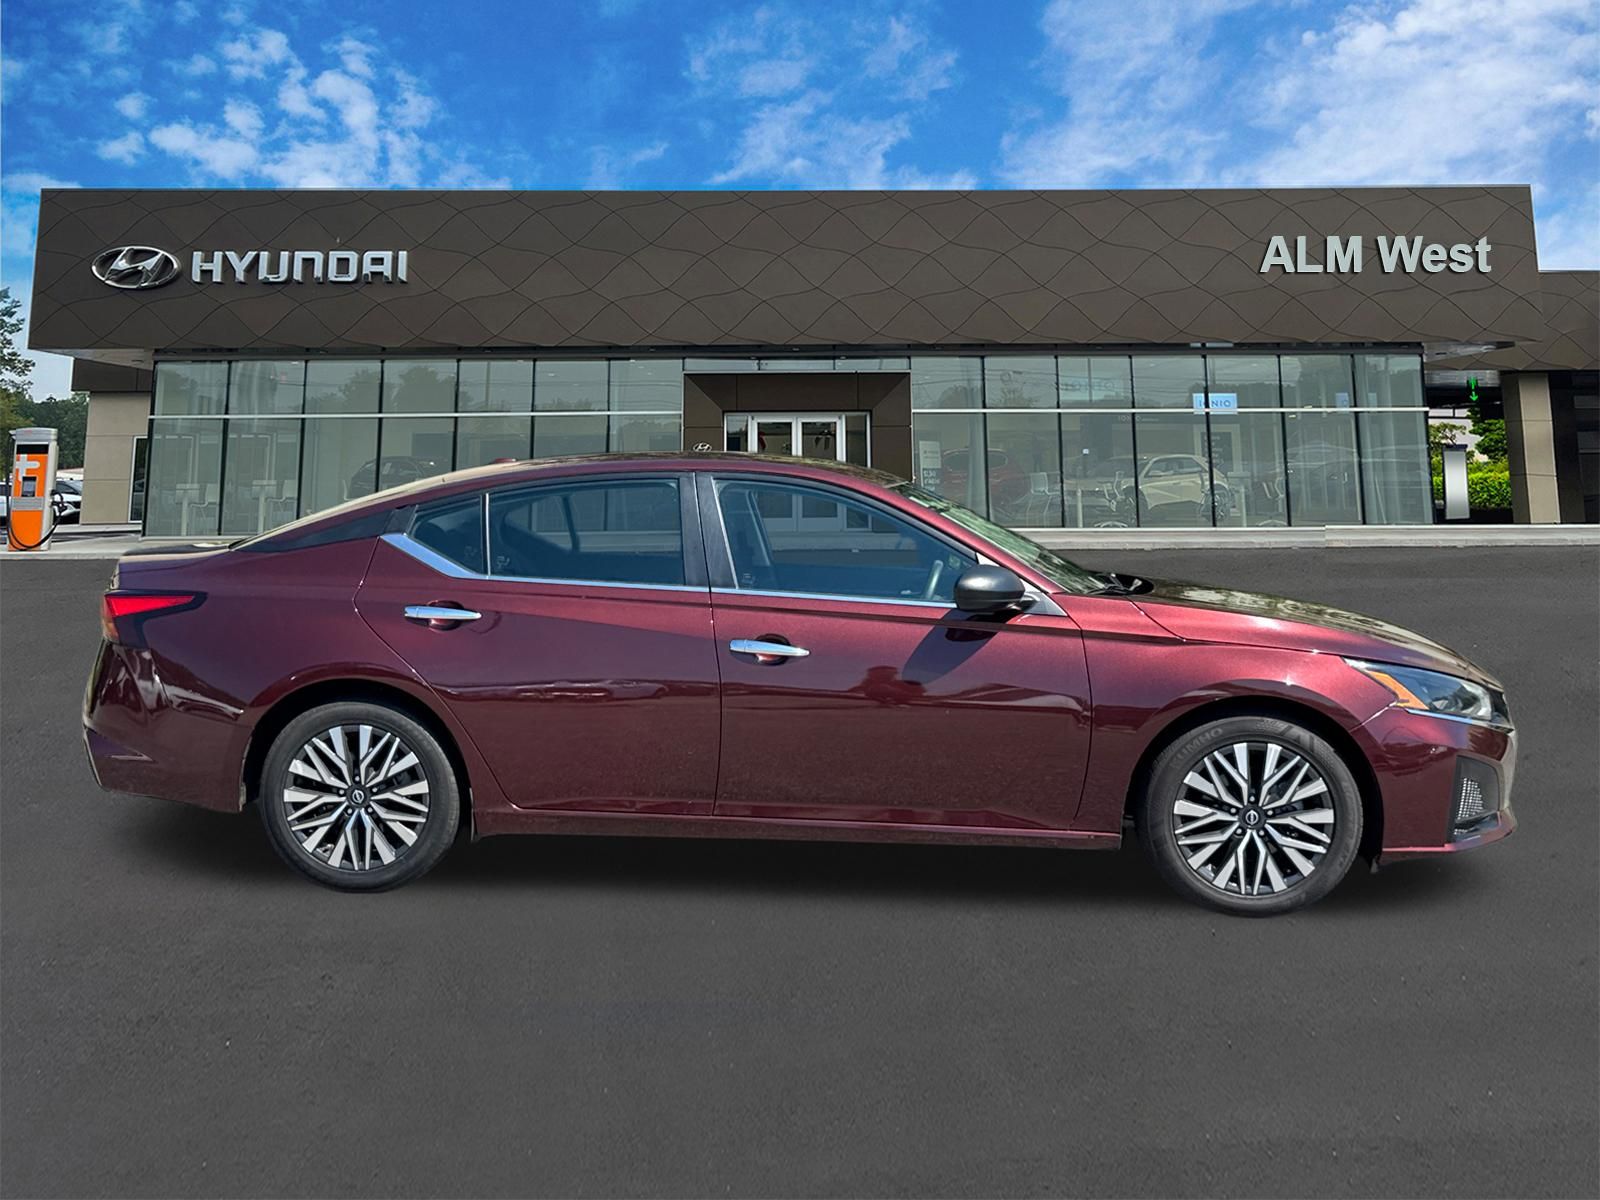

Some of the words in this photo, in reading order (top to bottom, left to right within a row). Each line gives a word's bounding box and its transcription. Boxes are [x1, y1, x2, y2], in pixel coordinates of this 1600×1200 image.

[191, 250, 409, 284] HYUNDAI
[1259, 235, 1363, 273] ALM
[1376, 235, 1492, 273] West
